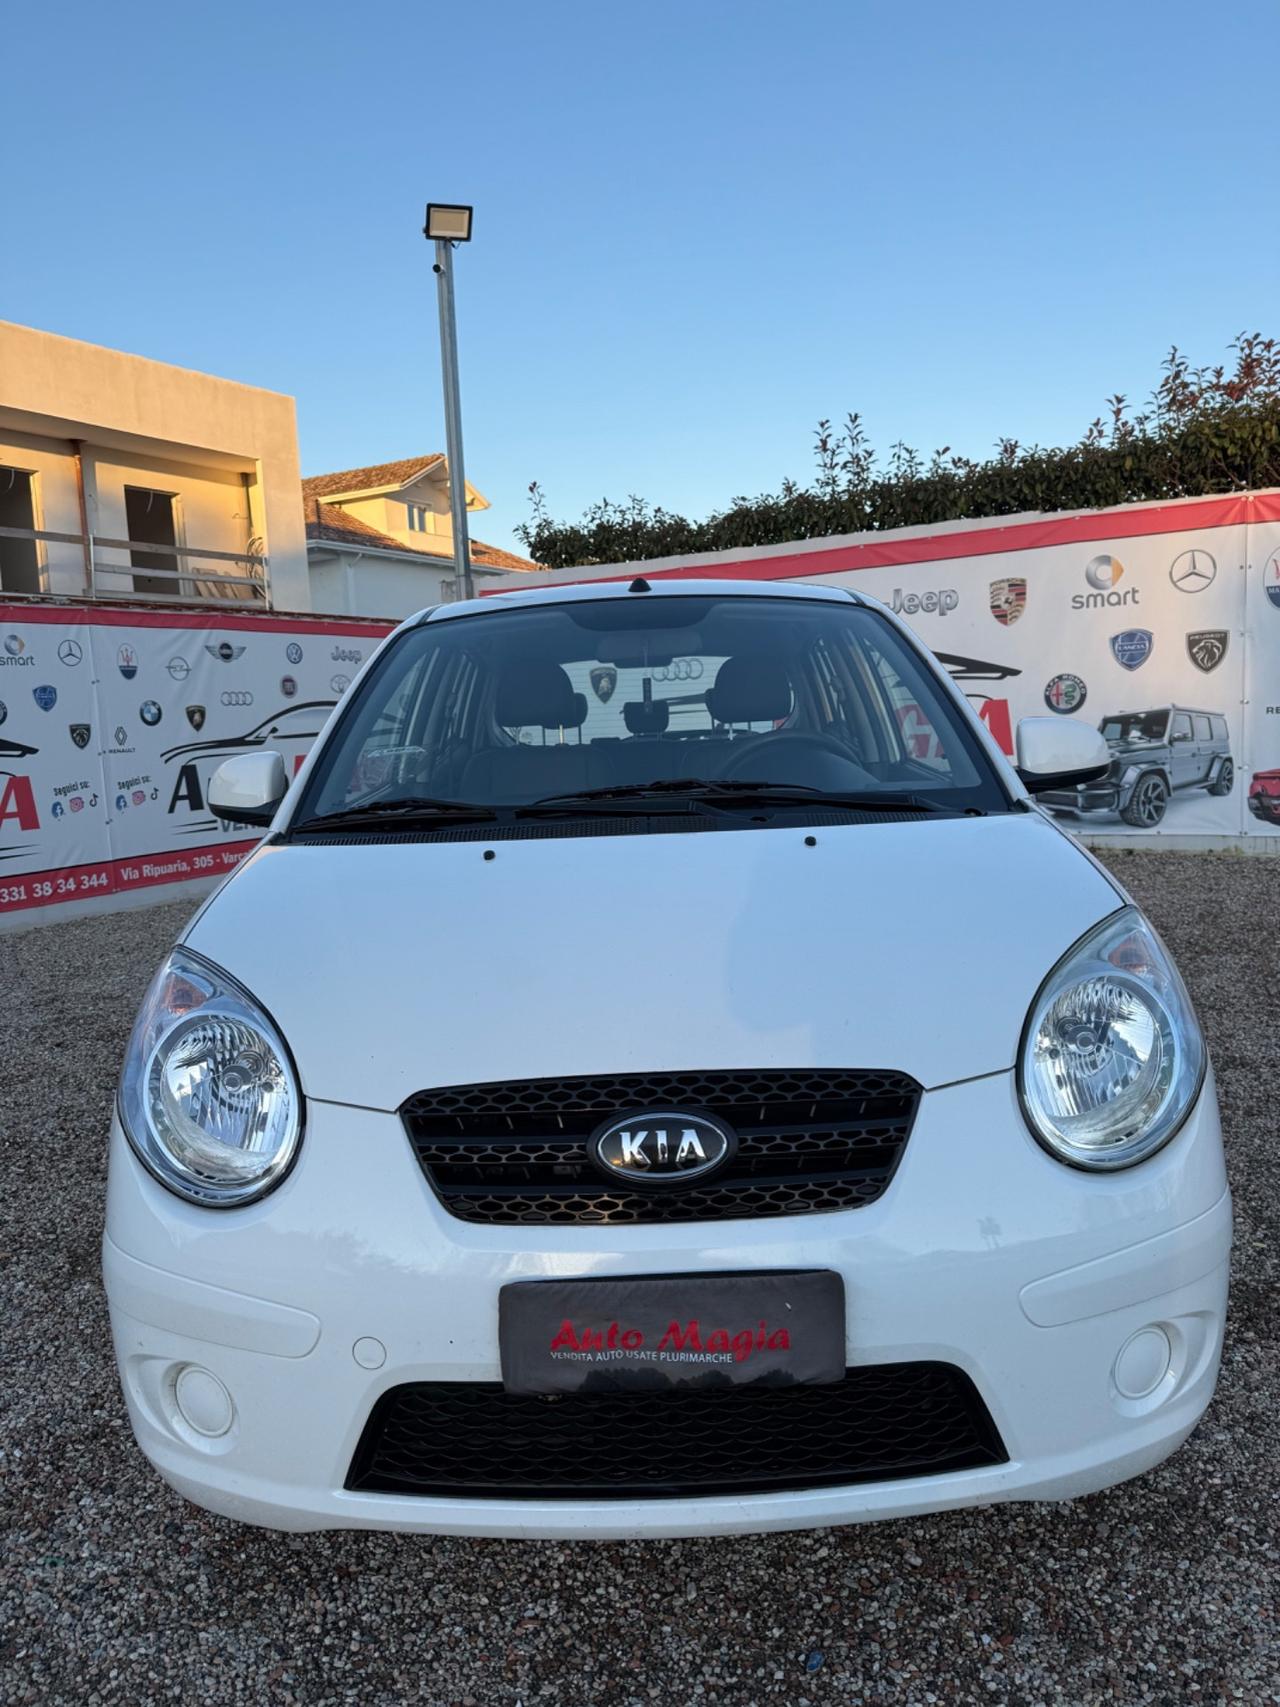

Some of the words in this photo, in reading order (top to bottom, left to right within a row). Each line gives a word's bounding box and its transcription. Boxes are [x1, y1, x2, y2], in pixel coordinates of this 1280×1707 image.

[886, 588, 959, 616] Jeep
[1071, 587, 1139, 610] smart
[0, 655, 35, 666] smart
[331, 645, 362, 665] Jeep
[121, 867, 140, 881] Via
[142, 860, 191, 877] Ripuaria,
[193, 855, 214, 869] 305
[0, 885, 27, 903] 331
[32, 881, 53, 898] 38
[57, 877, 77, 893] 34
[80, 872, 109, 889] 344
[619, 1128, 709, 1164] KIA
[550, 1318, 645, 1352] Auto
[657, 1318, 790, 1363] Magia
[550, 1351, 594, 1362] VENDITA
[596, 1350, 624, 1362] AUTO
[626, 1350, 657, 1361] USATE
[660, 1352, 733, 1364] PLURIMARCHE
